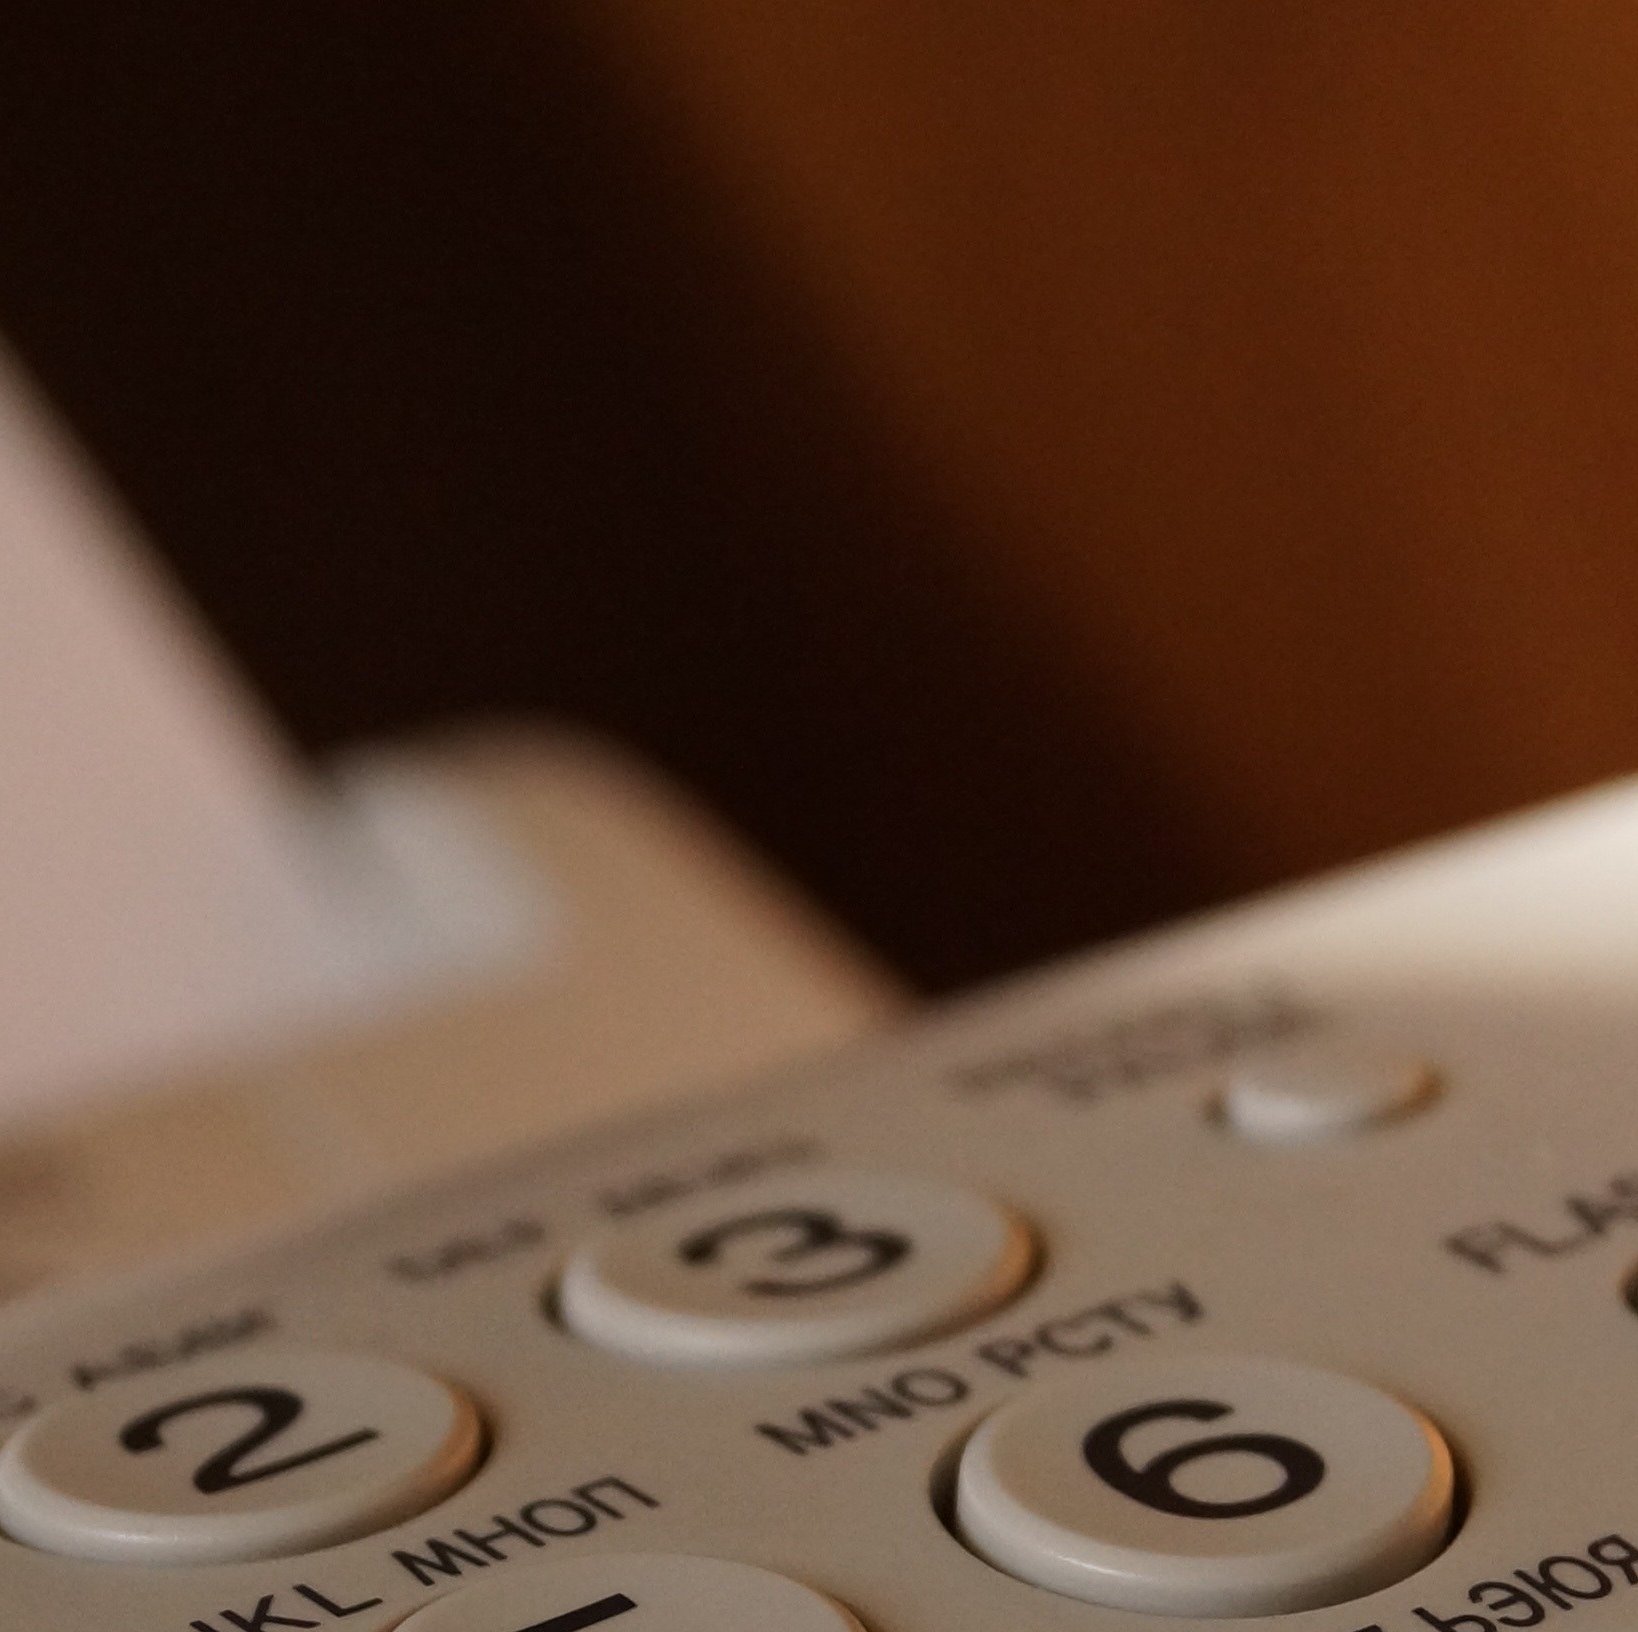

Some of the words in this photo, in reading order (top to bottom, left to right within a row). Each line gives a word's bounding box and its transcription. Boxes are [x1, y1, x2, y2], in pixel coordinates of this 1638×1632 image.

[675, 1205, 914, 1299] 3
[118, 1384, 379, 1494] 2
[753, 1366, 971, 1458] MNO
[1082, 1399, 1326, 1519] 6
[391, 1475, 661, 1587] МНОП
